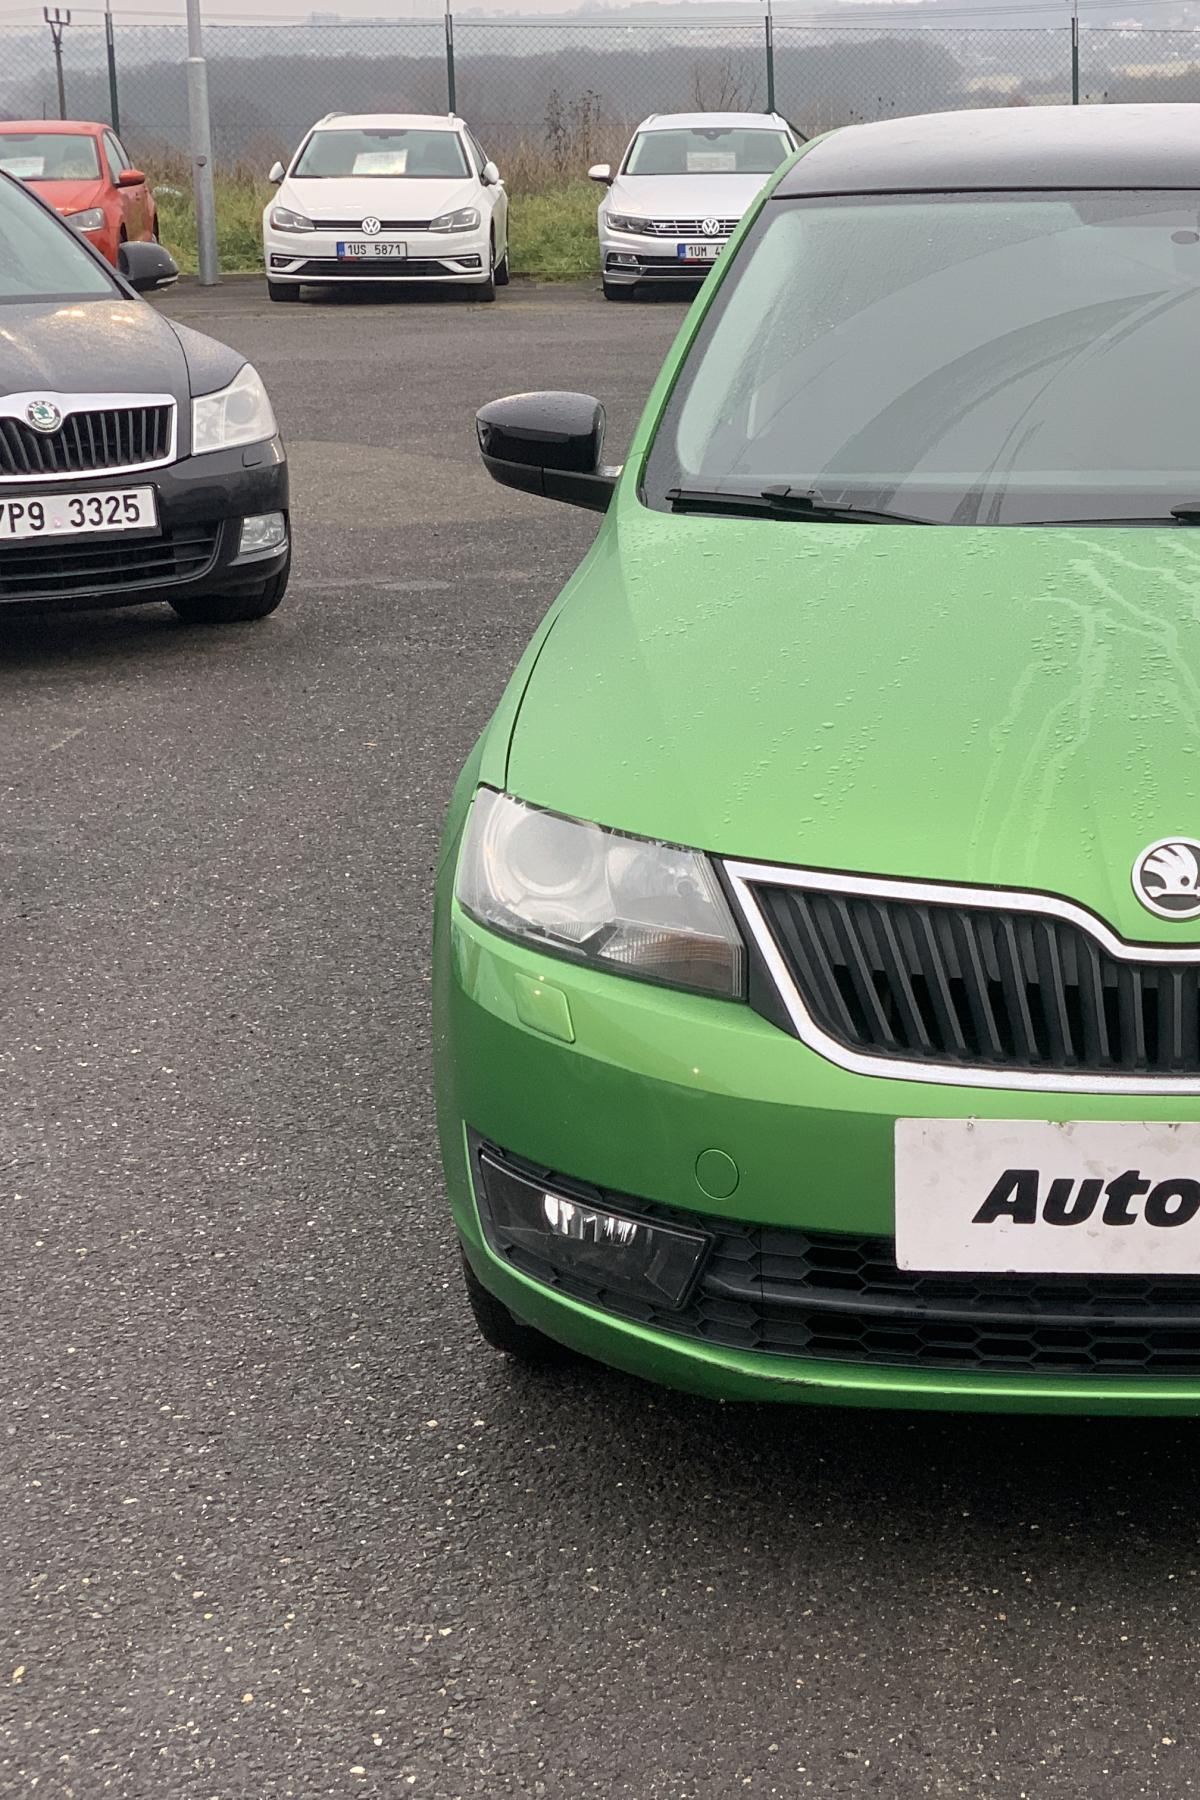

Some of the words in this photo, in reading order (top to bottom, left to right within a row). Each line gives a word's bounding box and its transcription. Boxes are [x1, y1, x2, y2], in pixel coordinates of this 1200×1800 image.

[347, 245, 367, 255] 1US
[374, 245, 401, 255] 5871
[689, 246, 707, 257] 1UM
[68, 493, 140, 527] 3325
